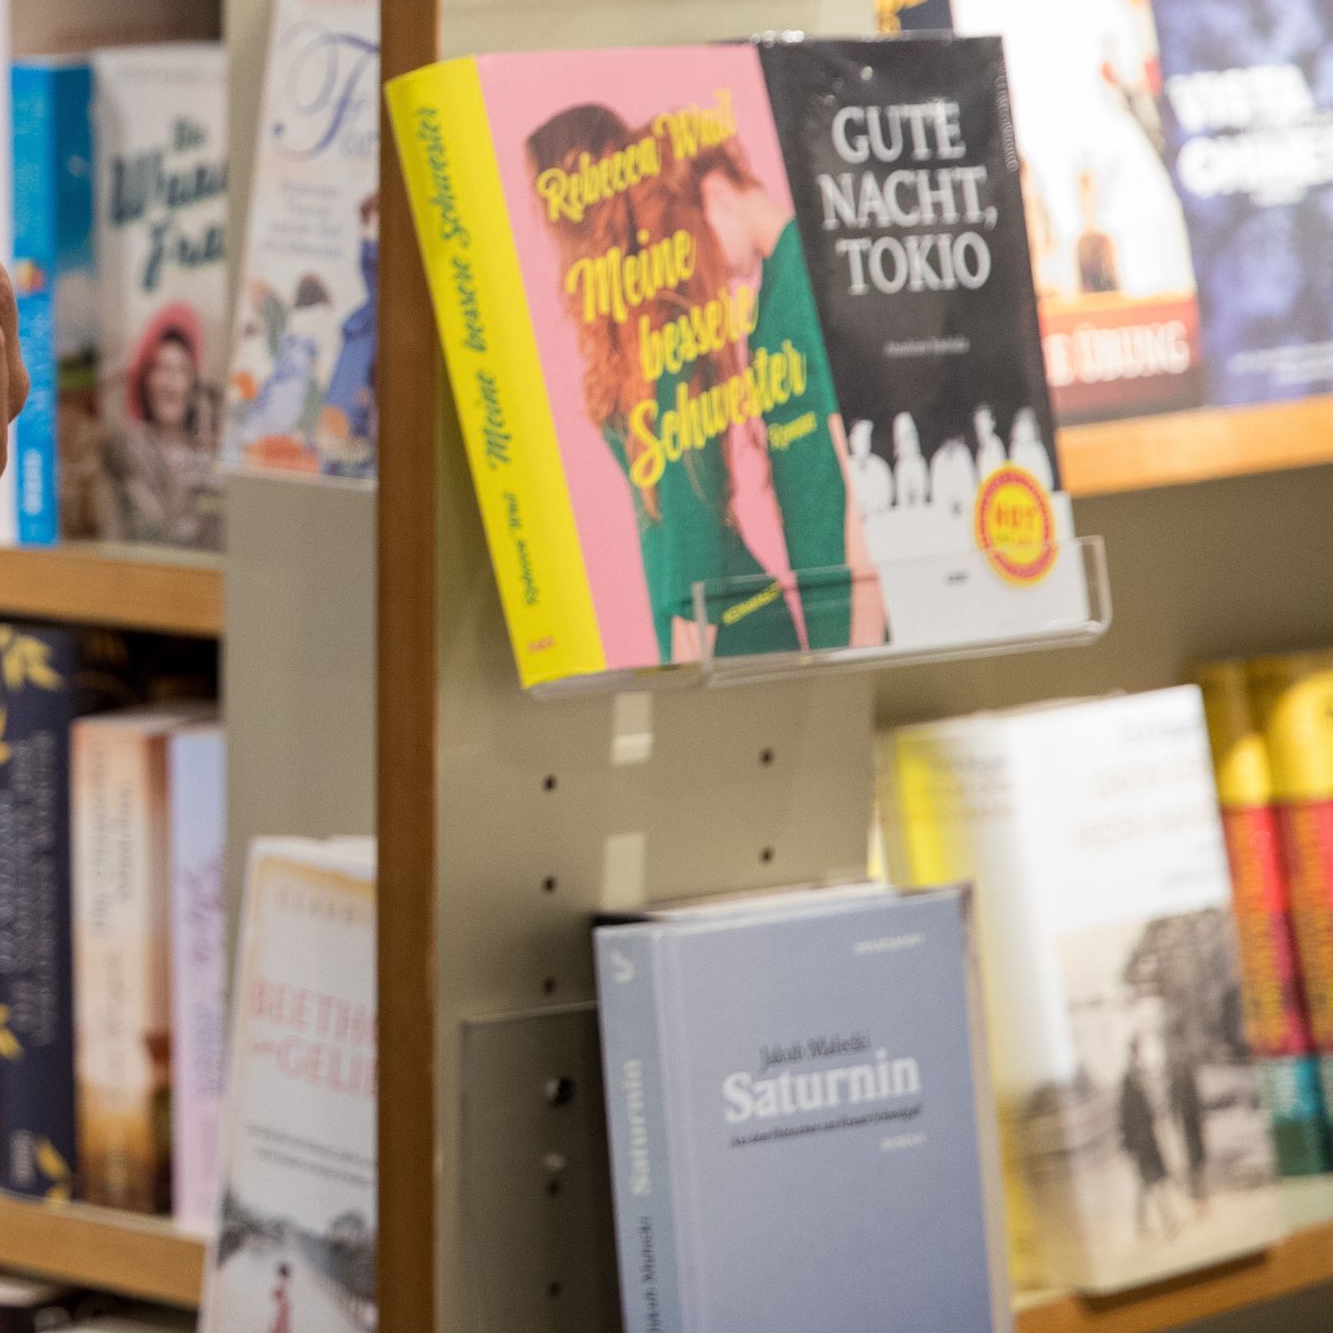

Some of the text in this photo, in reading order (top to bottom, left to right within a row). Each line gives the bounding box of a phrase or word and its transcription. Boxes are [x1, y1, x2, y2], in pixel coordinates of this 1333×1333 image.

[416, 105, 471, 249] Schwester
[536, 136, 661, 222] Rebecca
[832, 98, 967, 164] GUTE
[817, 164, 998, 231] NACHT,
[565, 228, 695, 324] Meine
[835, 231, 991, 295] TOKIO
[639, 284, 759, 383] bessere
[476, 370, 512, 470] Meine
[628, 338, 807, 489] Schwester
[622, 1057, 653, 1196] Saturnin
[722, 1047, 921, 1124] Saturnin
